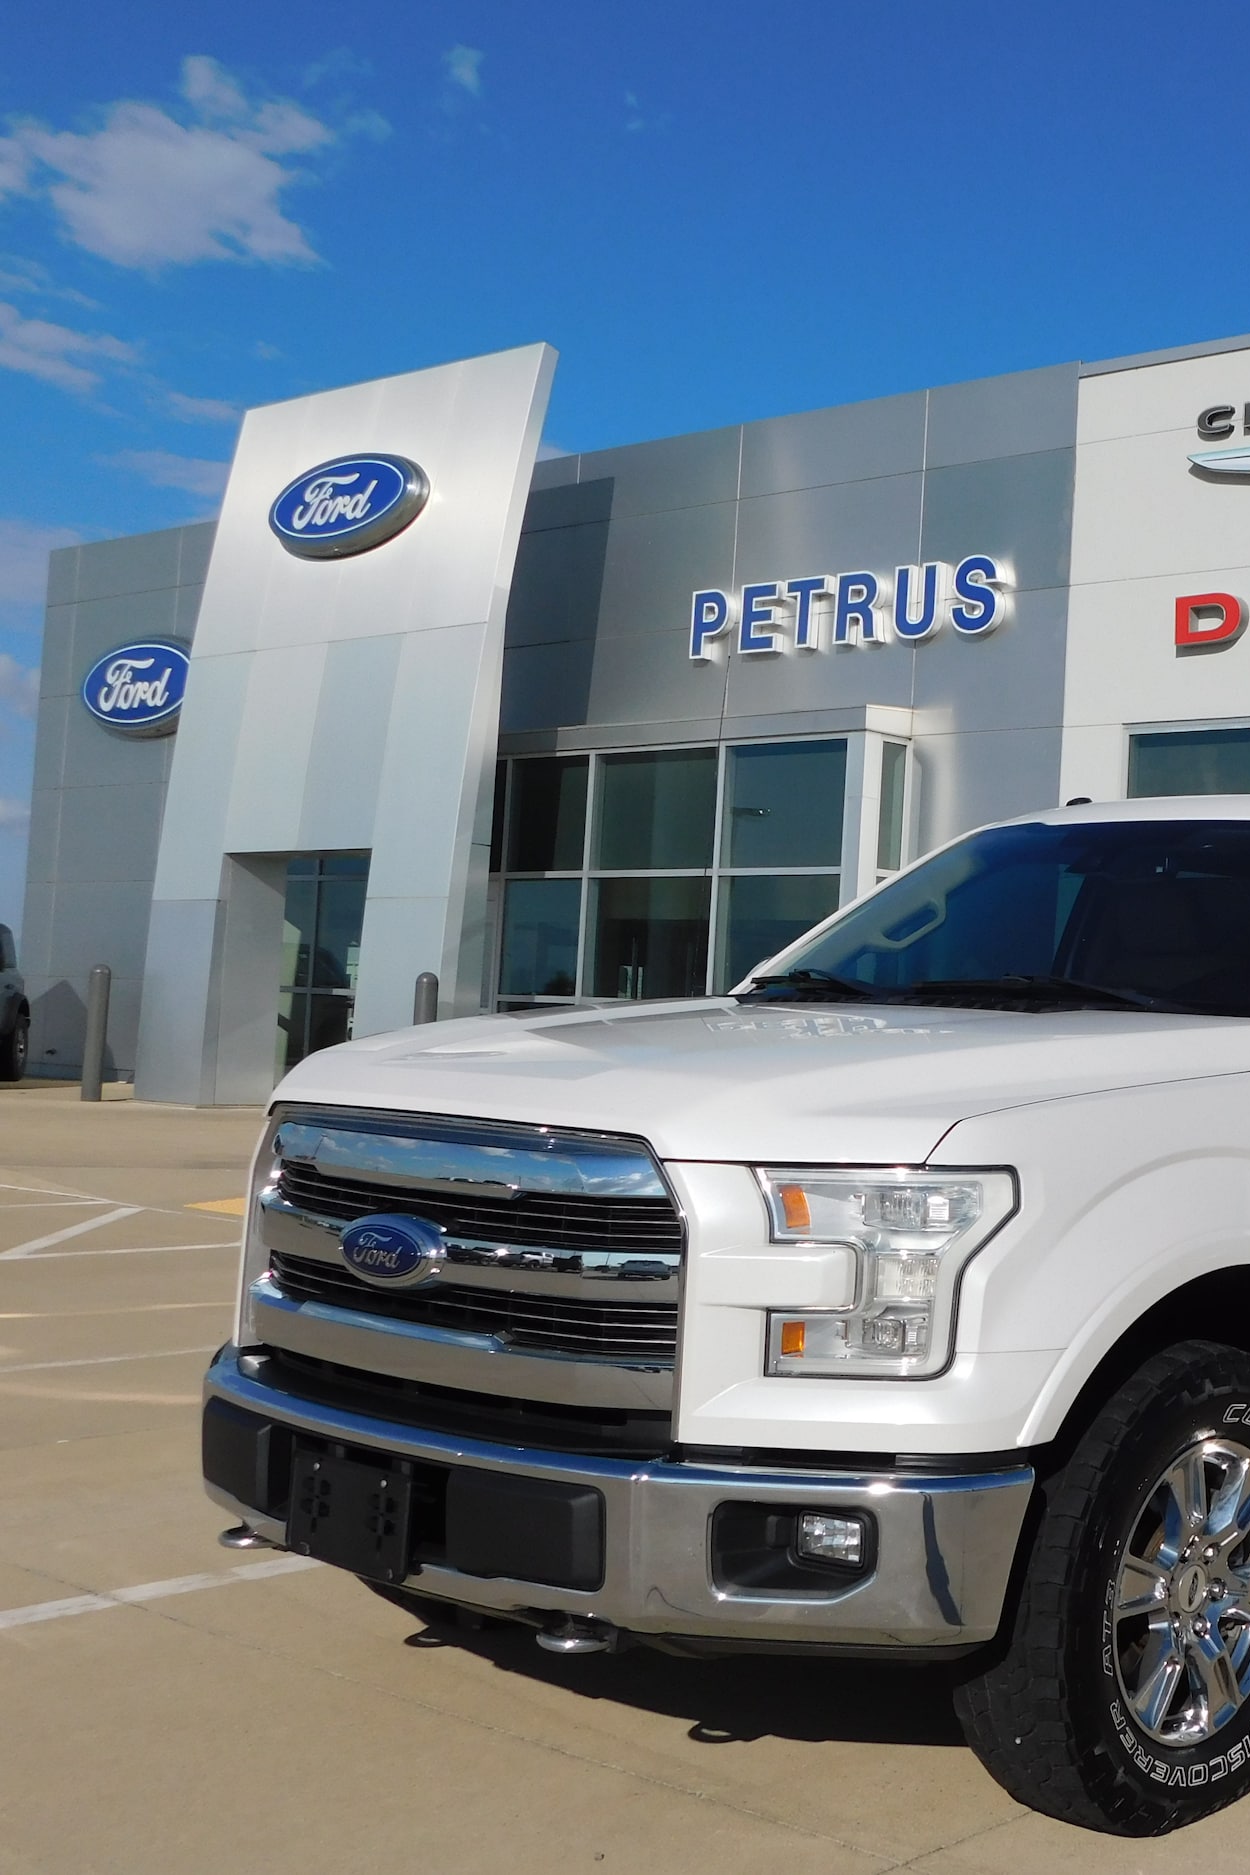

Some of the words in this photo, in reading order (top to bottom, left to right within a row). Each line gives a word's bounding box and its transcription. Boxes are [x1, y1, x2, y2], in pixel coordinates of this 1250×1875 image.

[292, 472, 378, 530] Ford
[689, 554, 1006, 661] PETRUS
[99, 658, 172, 712] Ford
[353, 1231, 404, 1269] Ford
